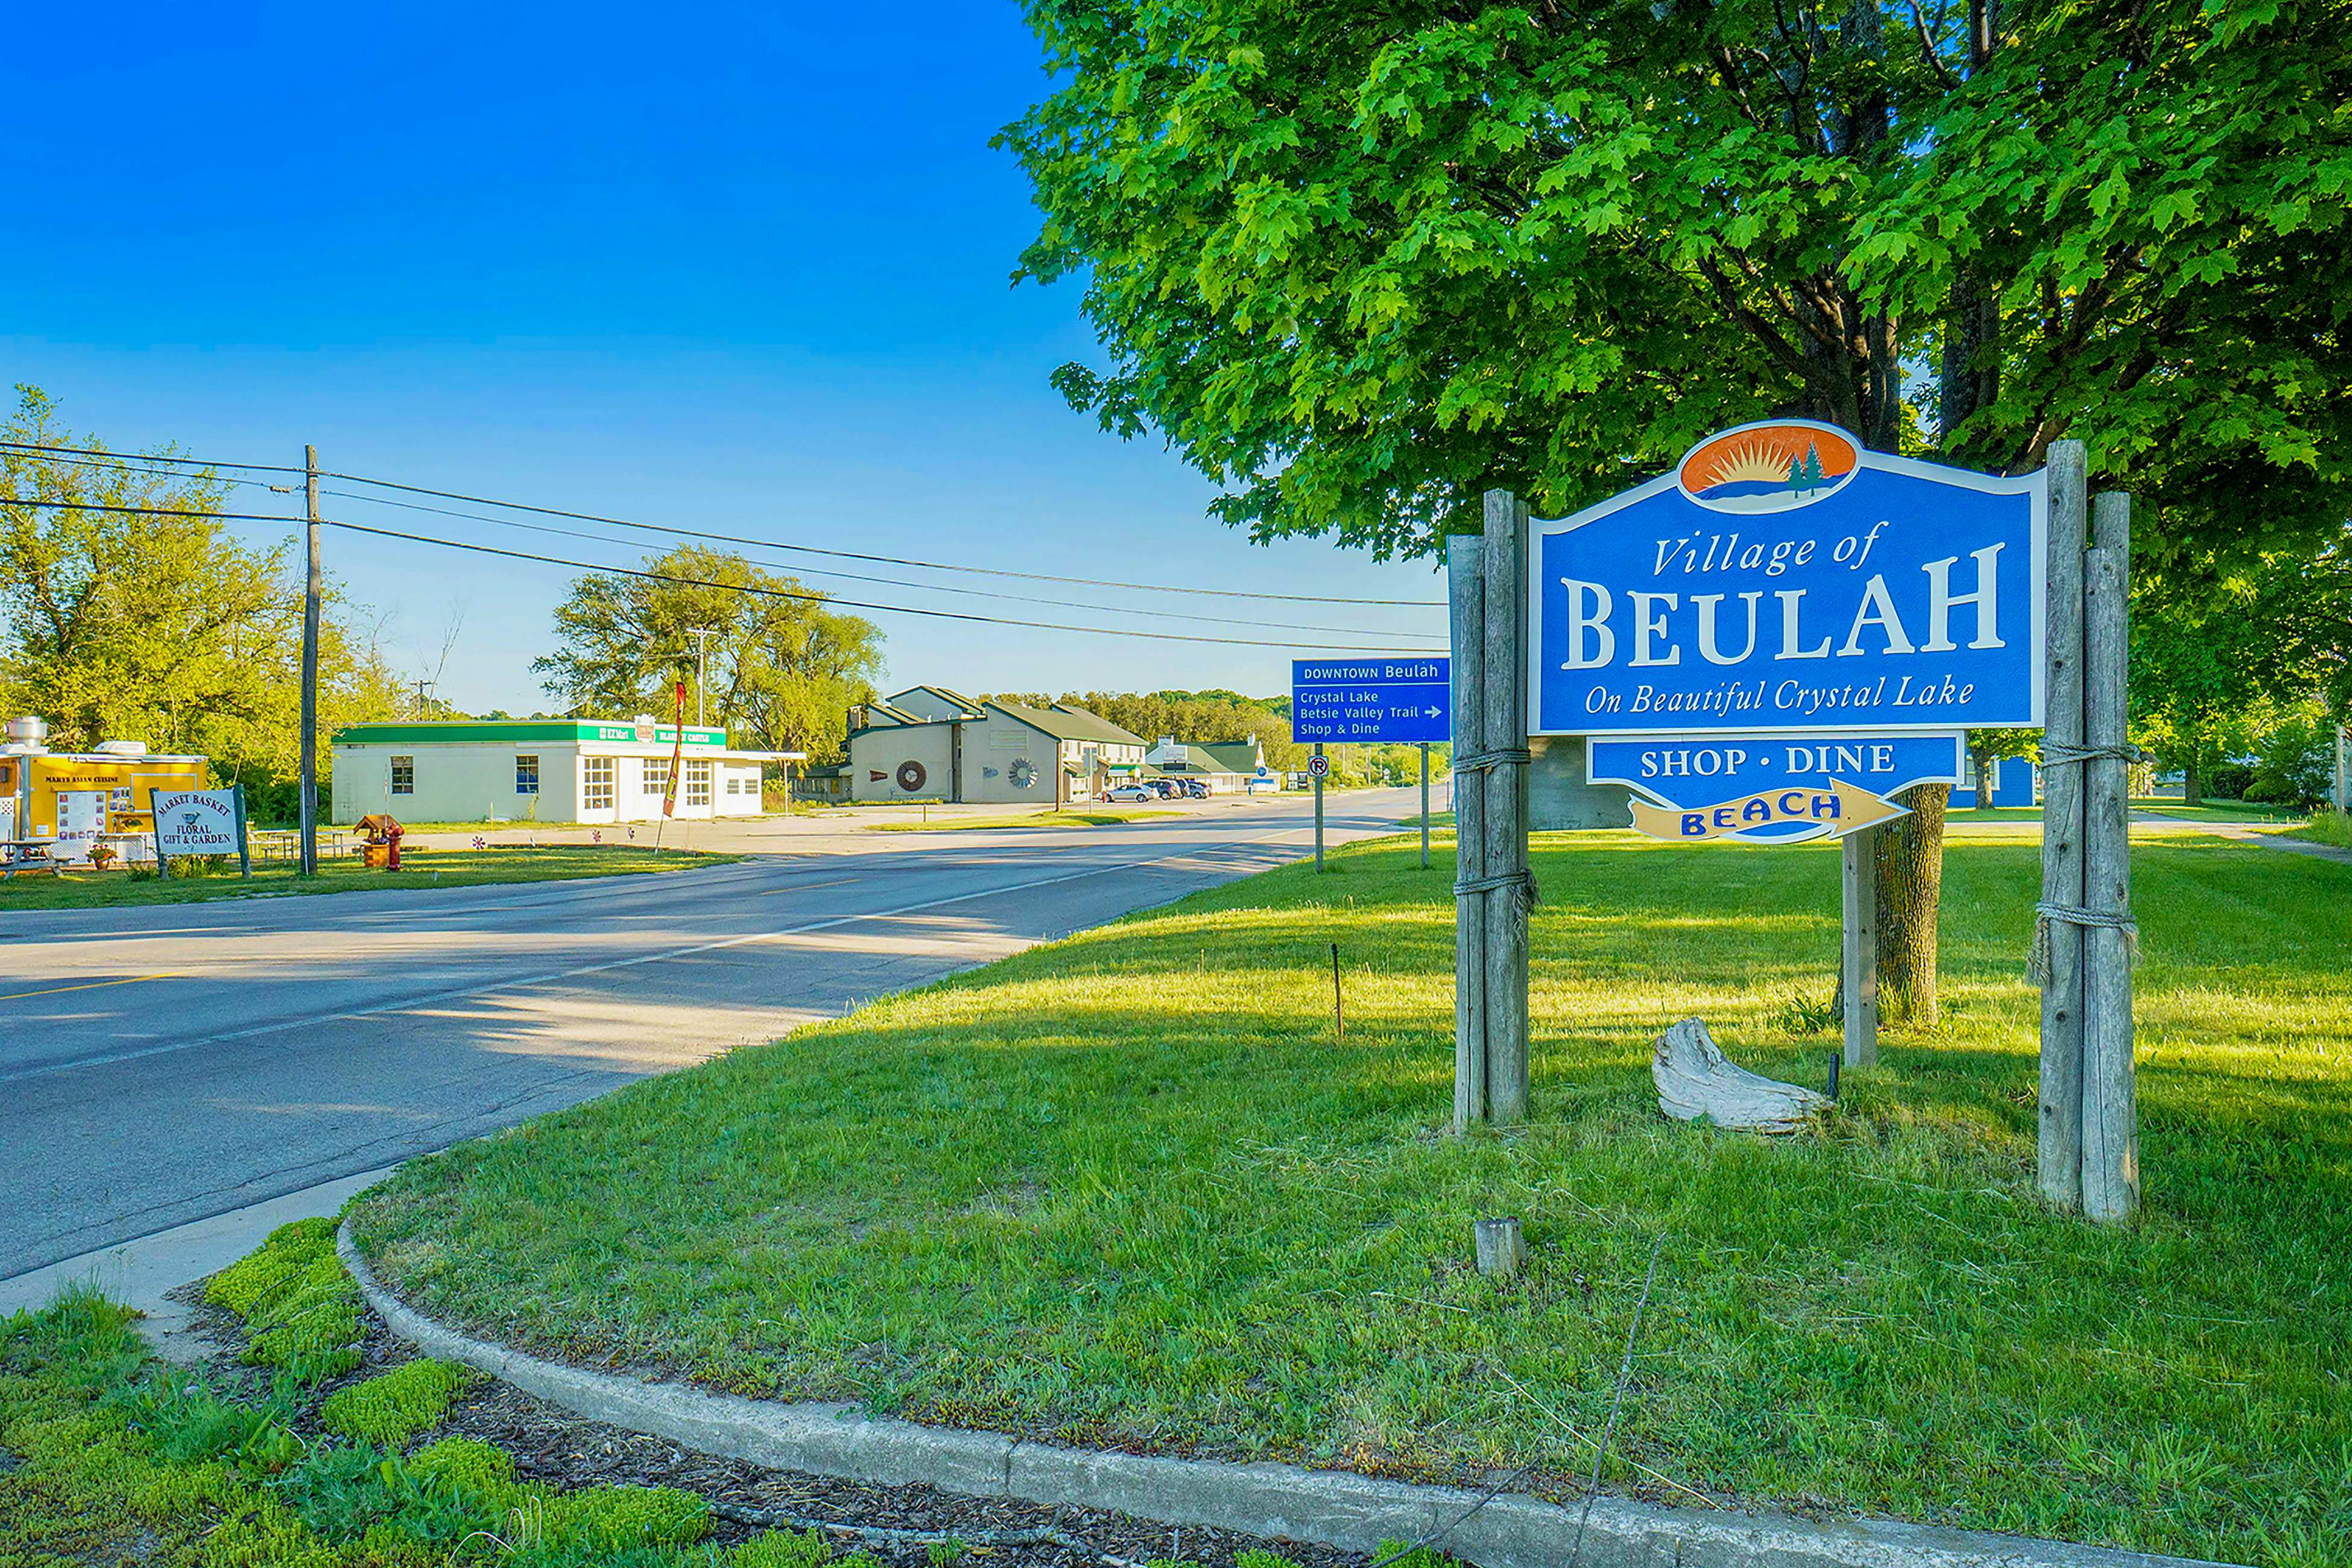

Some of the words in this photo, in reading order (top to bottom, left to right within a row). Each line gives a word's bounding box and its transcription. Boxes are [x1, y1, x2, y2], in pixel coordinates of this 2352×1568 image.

[1654, 530, 1816, 577] Village
[1833, 521, 1889, 570] of
[1560, 542, 2006, 670] BEULAH
[1304, 668, 1379, 679] DOWNTOWN
[1385, 665, 1438, 678] Beulah
[1300, 692, 1344, 705] Crystal
[1349, 691, 1379, 703] Lake
[1585, 685, 1621, 714] On
[1630, 680, 1767, 717] Beautiful
[1775, 677, 1886, 715] Crystal
[1892, 674, 1974, 706] Lake
[1300, 708, 1339, 719] Betsie
[1344, 707, 1383, 721] Valley
[1389, 707, 1418, 718] Trail
[1300, 724, 1331, 736] Shop
[1336, 724, 1346, 734] &
[1351, 723, 1380, 734] Dine
[1640, 749, 1747, 777] SHOP
[1786, 745, 1895, 774] DINE
[158, 794, 189, 818] MARKET
[192, 794, 231, 817] BASKET
[1680, 792, 1842, 836] BEACH
[163, 835, 181, 844] GIFT
[183, 835, 189, 844] &
[191, 833, 230, 845] GARDEN
[177, 824, 212, 835] FLORAL
